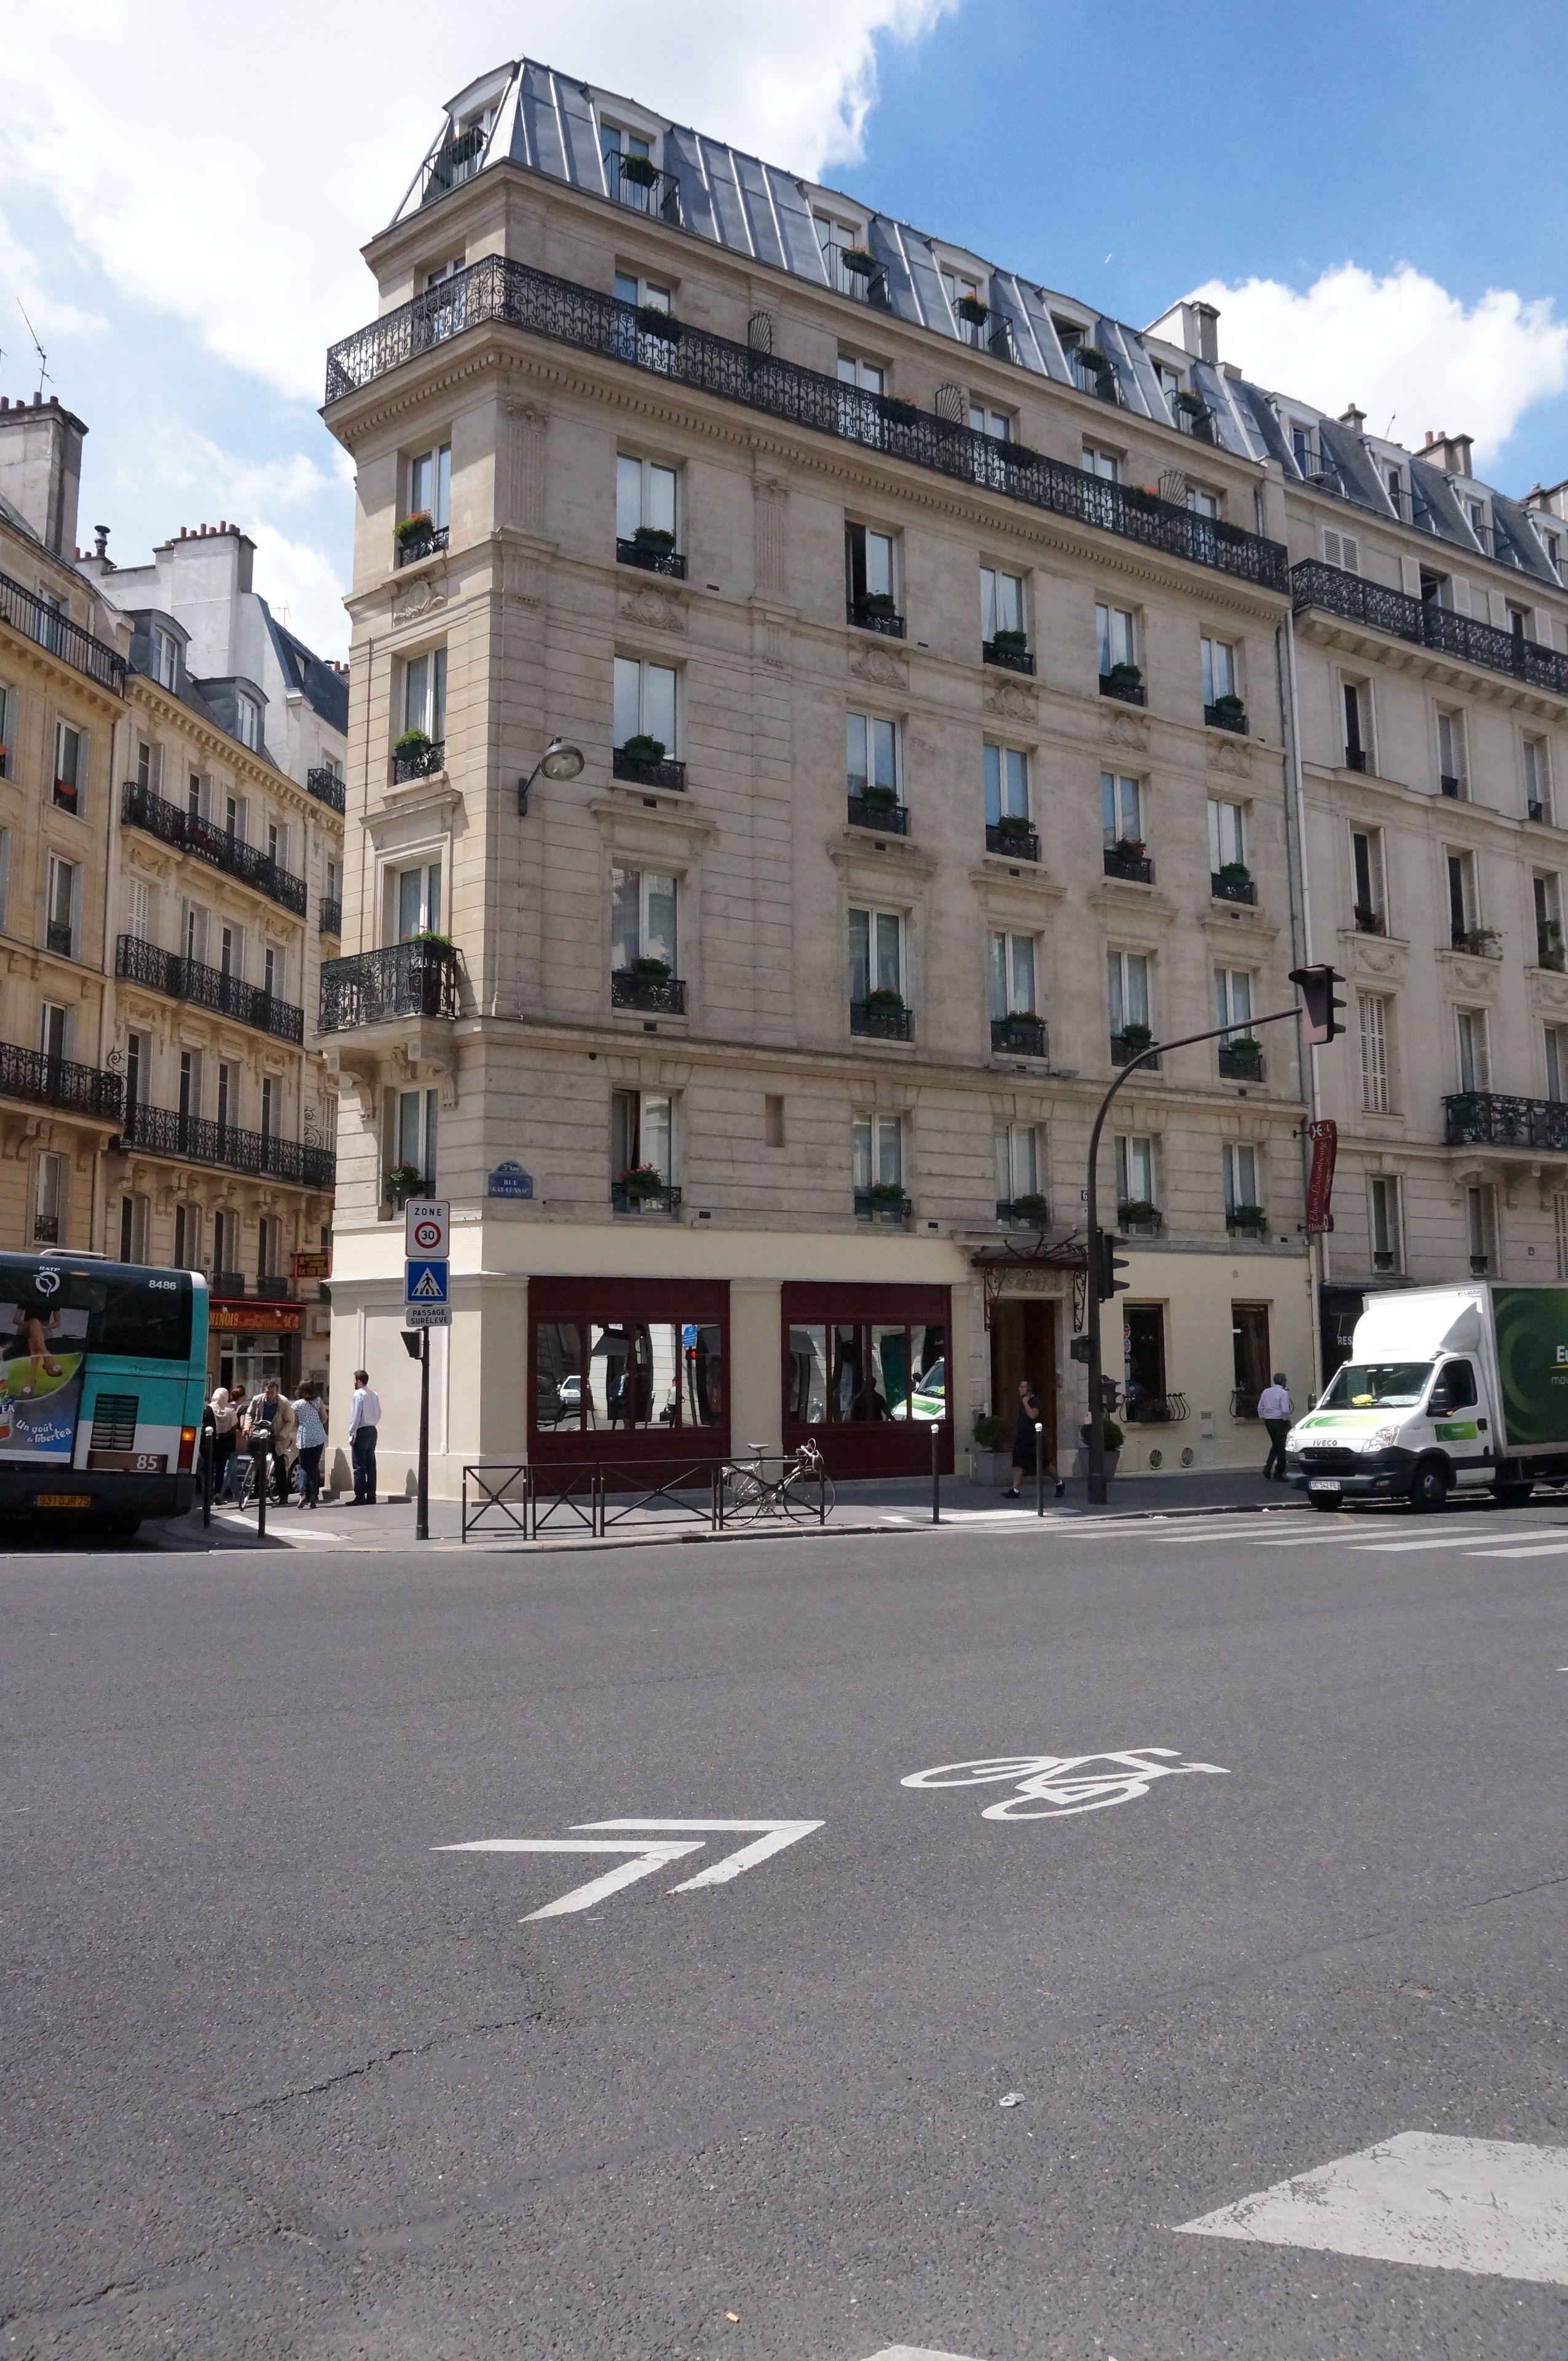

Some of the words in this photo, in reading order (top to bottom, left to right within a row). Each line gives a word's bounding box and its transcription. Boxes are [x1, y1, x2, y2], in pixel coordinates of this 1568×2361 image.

[1083, 1191, 1088, 1200] 6
[414, 1208, 442, 1216] ZONE
[422, 1230, 435, 1240] 30
[149, 1280, 176, 1290] 8486
[1337, 1335, 1352, 1345] RES
[0, 1404, 15, 1413] EA
[16, 1419, 30, 1431] Un
[31, 1422, 53, 1434] goût
[35, 1428, 73, 1442] libertea
[136, 1455, 157, 1469] 85
